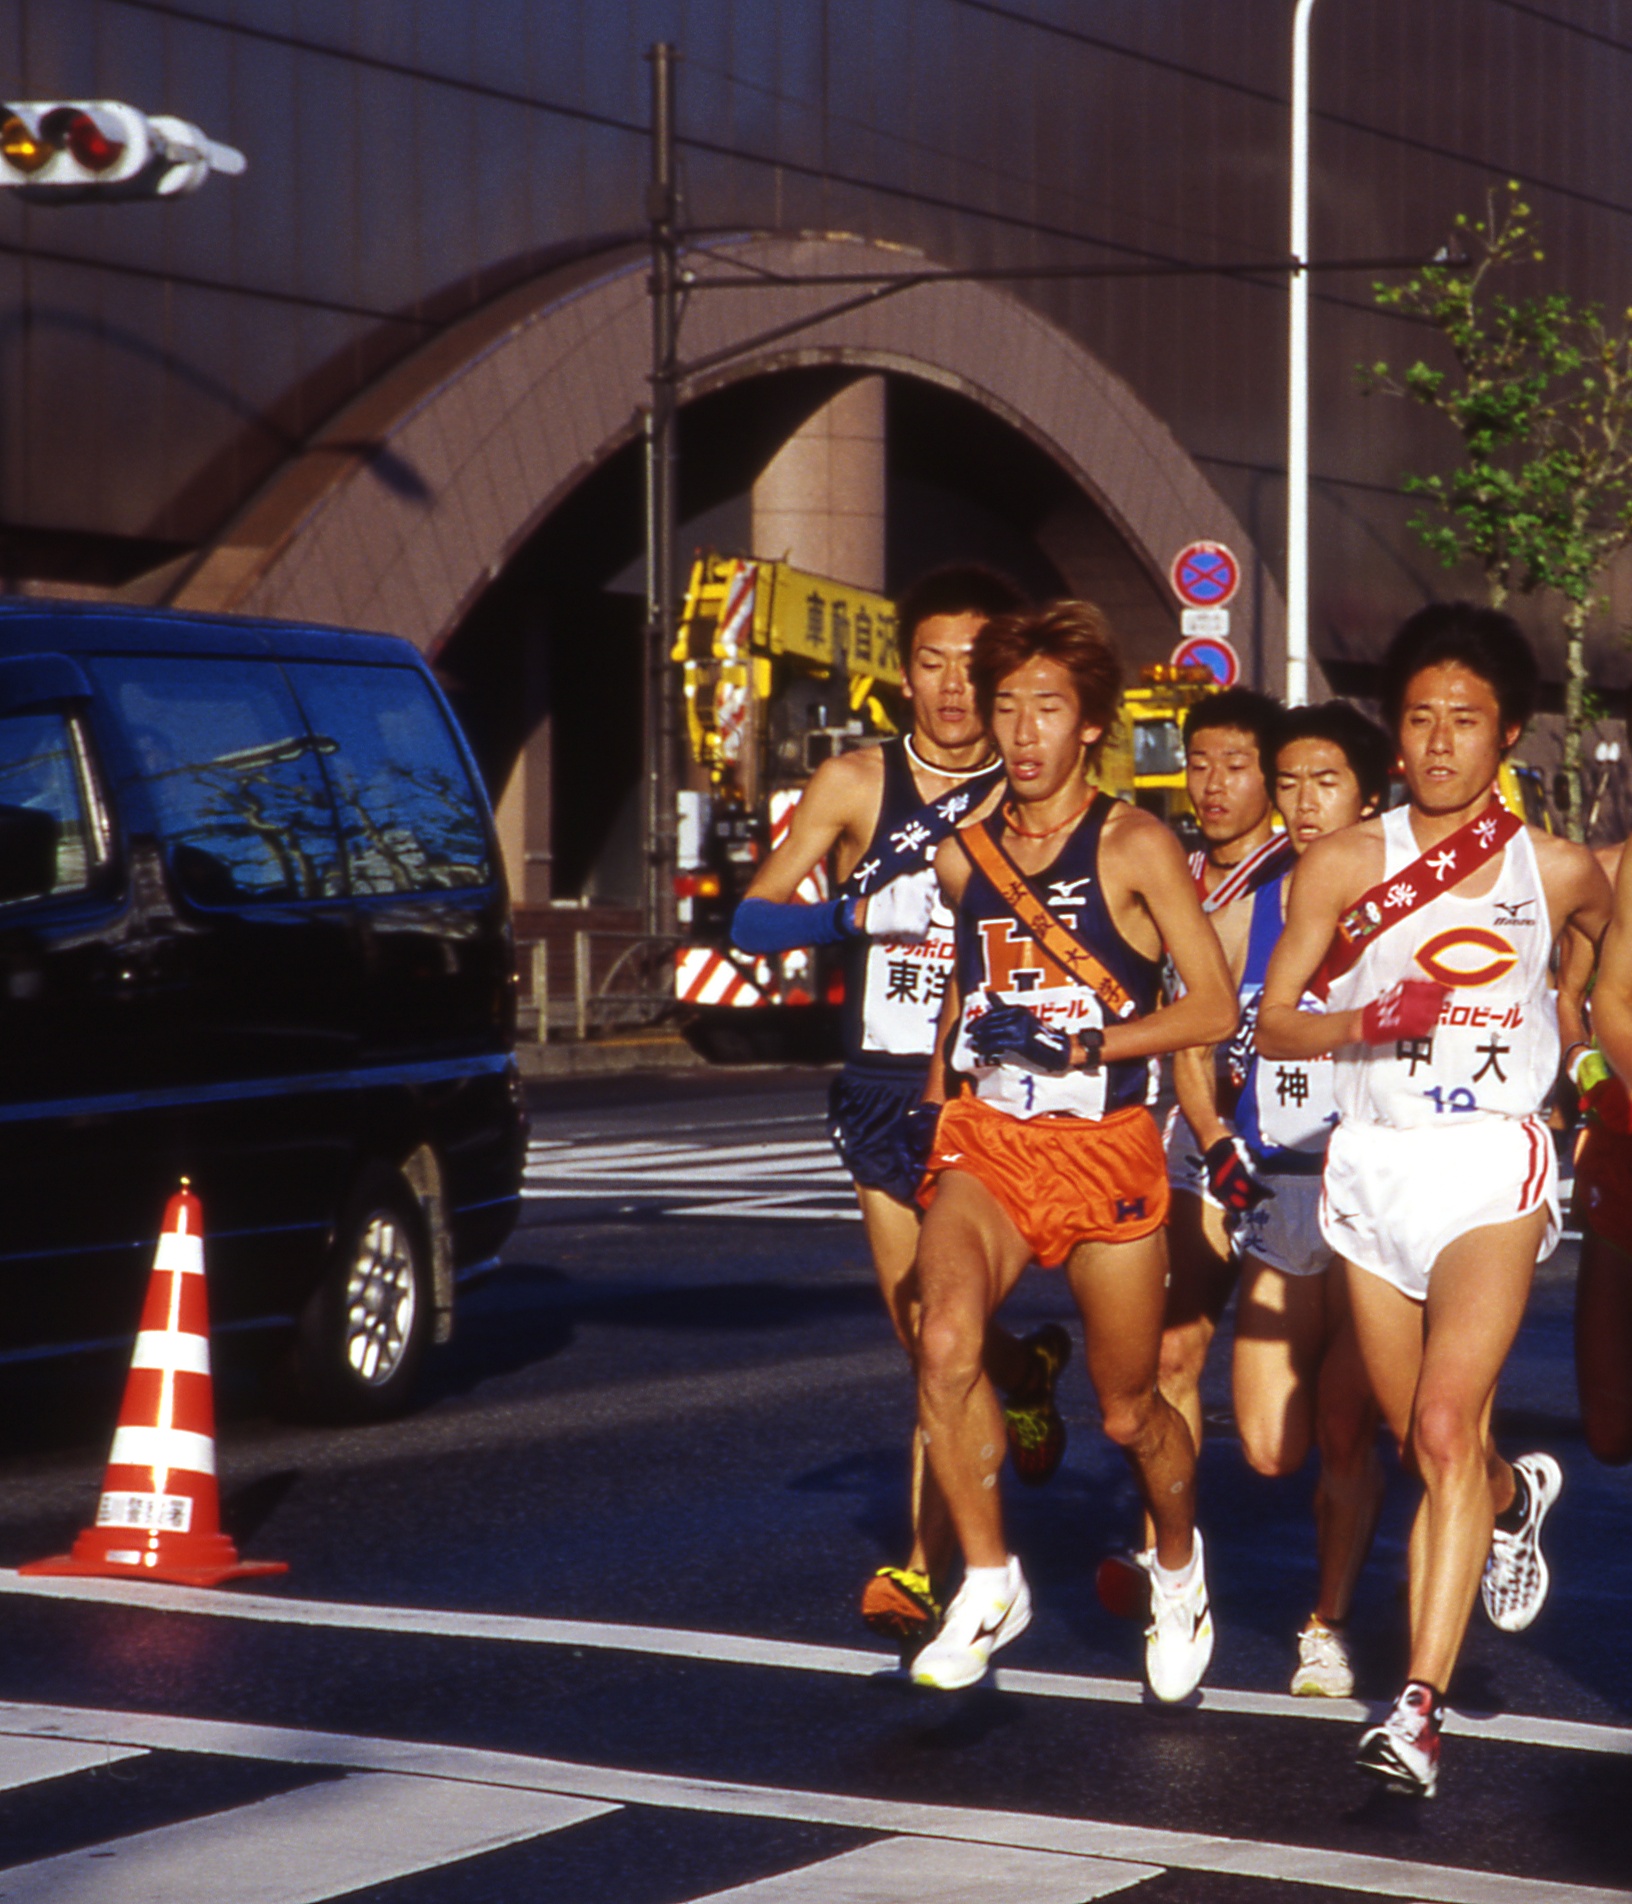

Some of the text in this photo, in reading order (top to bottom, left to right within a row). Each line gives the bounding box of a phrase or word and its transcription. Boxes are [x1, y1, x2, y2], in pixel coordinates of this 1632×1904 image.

[840, 793, 970, 901] 東洋大
[1018, 1073, 1035, 1112] 1
[1115, 1197, 1146, 1223] H
